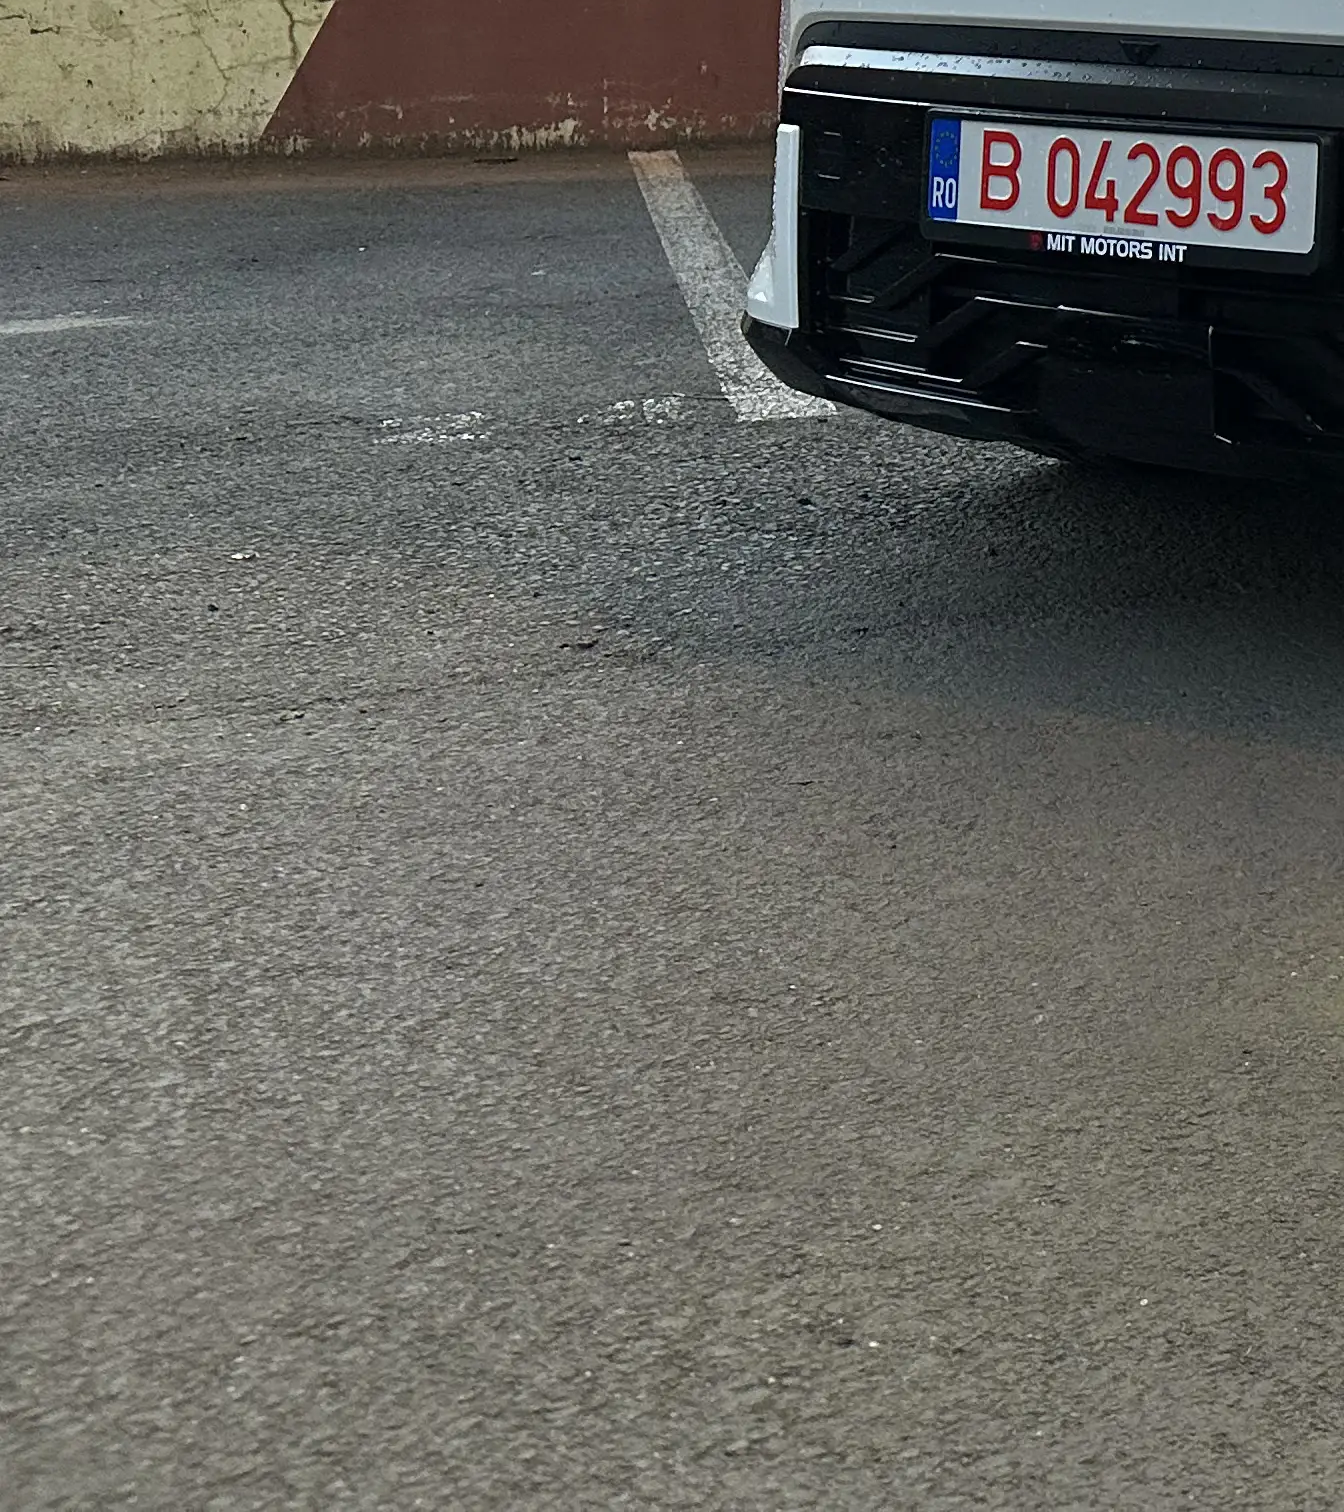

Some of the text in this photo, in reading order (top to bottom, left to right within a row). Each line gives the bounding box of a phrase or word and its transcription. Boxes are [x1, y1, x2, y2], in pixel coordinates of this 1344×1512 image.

[931, 176, 957, 209] RO
[980, 129, 1289, 235] B 042993
[1047, 233, 1188, 263] MIT MOTORS INT
